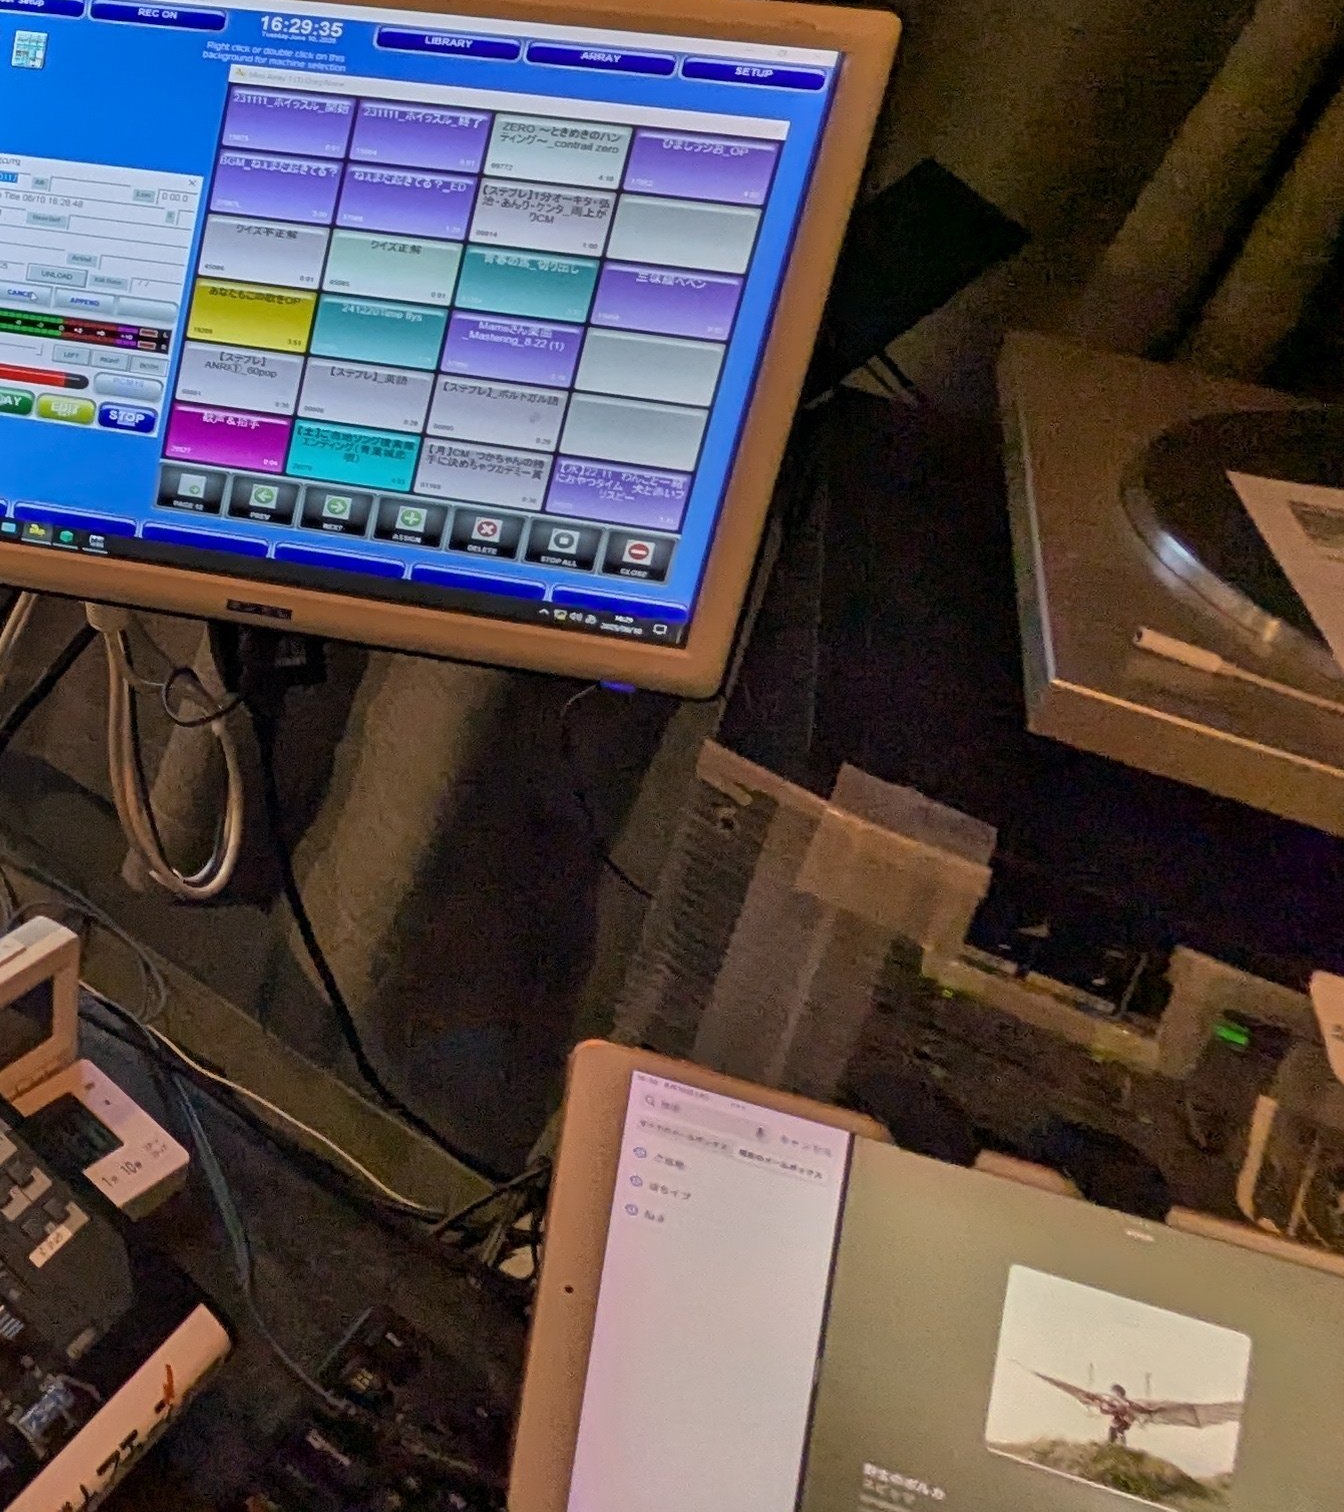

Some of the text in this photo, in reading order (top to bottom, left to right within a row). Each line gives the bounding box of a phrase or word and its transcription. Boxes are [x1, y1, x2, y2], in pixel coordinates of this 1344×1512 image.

[138, 8, 178, 20] REC ON
[260, 15, 344, 38] 16:29:35
[424, 35, 473, 49] LIBRARY
[207, 40, 345, 63] Right click or double click on this
[202, 50, 346, 72] background for machine selection
[580, 51, 622, 64] ARRAY
[734, 66, 774, 79] SETUP
[502, 123, 536, 134] ZERO
[595, 144, 619, 154] zero
[3, 192, 20, 201] Title
[236, 224, 298, 240] クイズ不正解
[370, 240, 422, 255] クイズ正解
[41, 270, 73, 281] UNLOAD
[70, 297, 100, 308] APPEND
[549, 341, 565, 352] (1)
[108, 410, 145, 424] STOP
[250, 511, 271, 521] PREV
[322, 522, 344, 531] NEXT
[391, 533, 421, 543] ASSIGN
[467, 544, 498, 555] DELETE
[540, 555, 577, 568] STOP ALL
[620, 567, 648, 578] CLOSE
